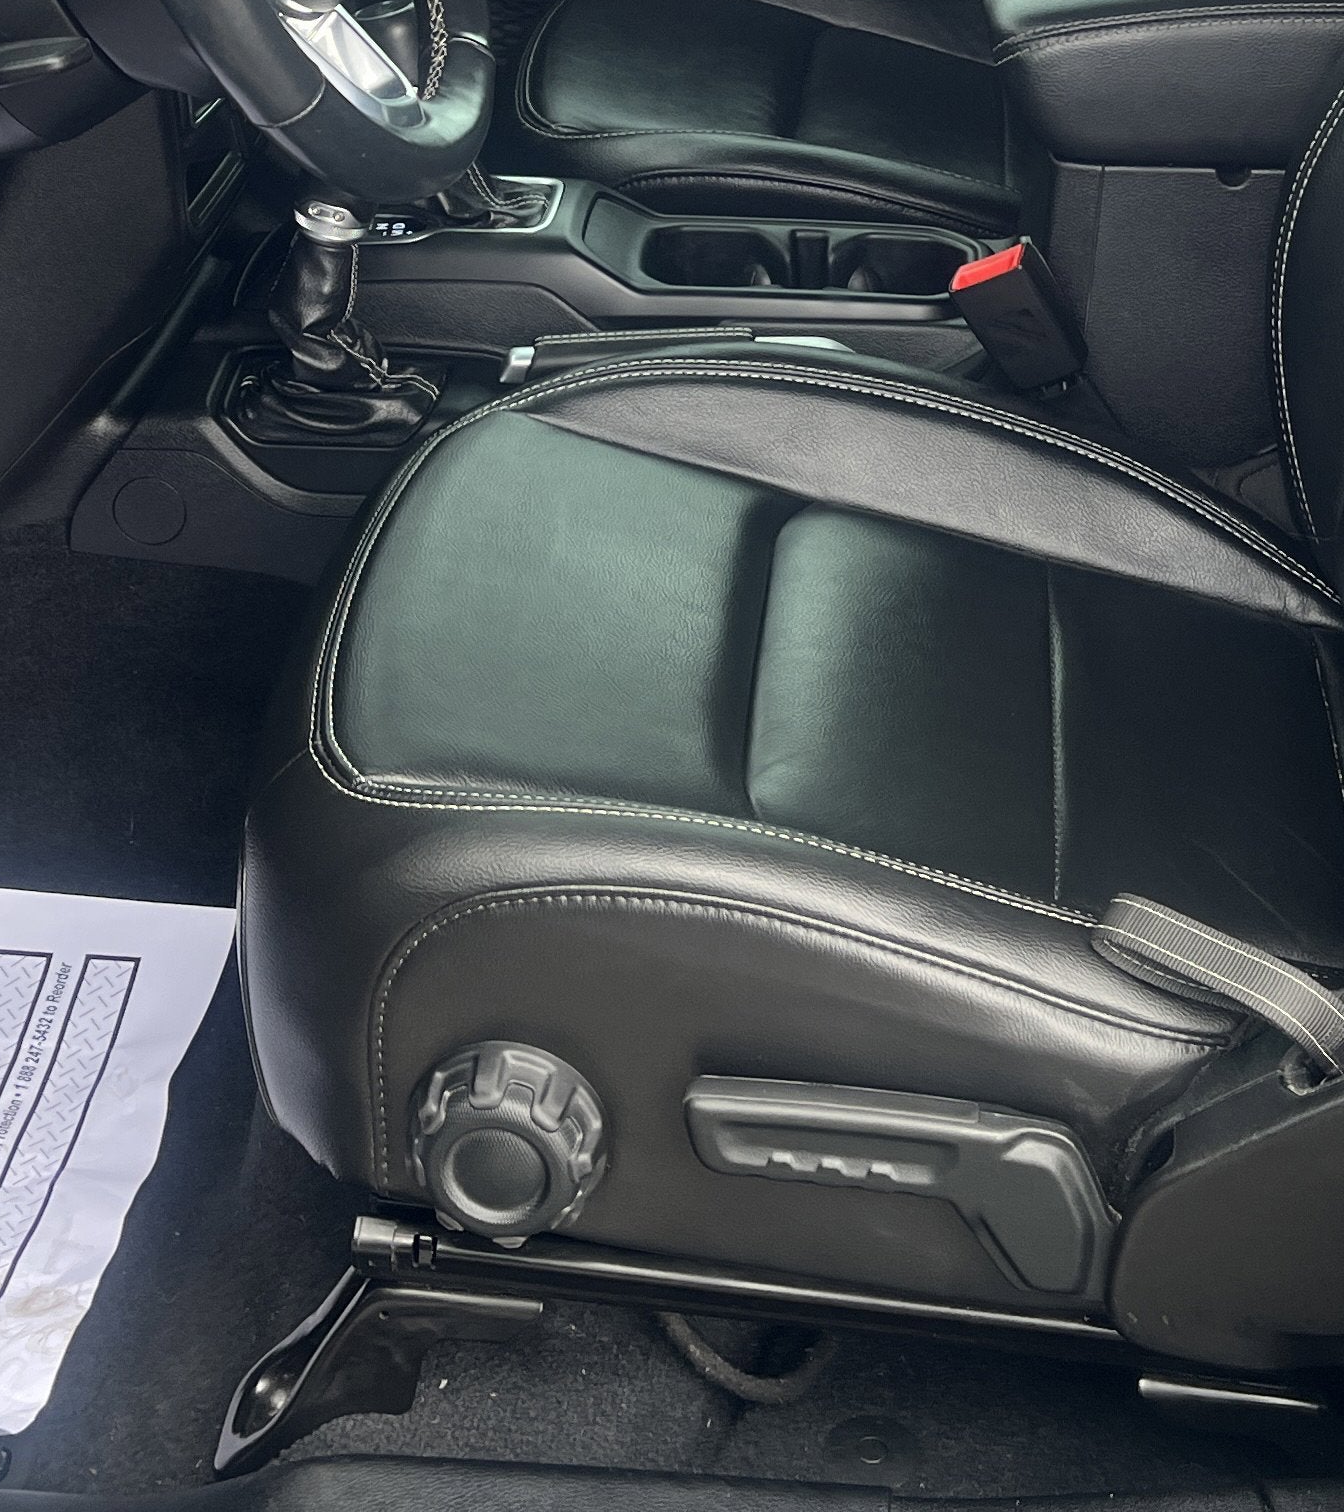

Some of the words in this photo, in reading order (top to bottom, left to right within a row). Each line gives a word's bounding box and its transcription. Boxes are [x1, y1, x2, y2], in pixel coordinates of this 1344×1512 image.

[46, 962, 72, 1003] Reorder
[43, 1005, 57, 1016] to
[25, 1017, 53, 1064] 247-5432
